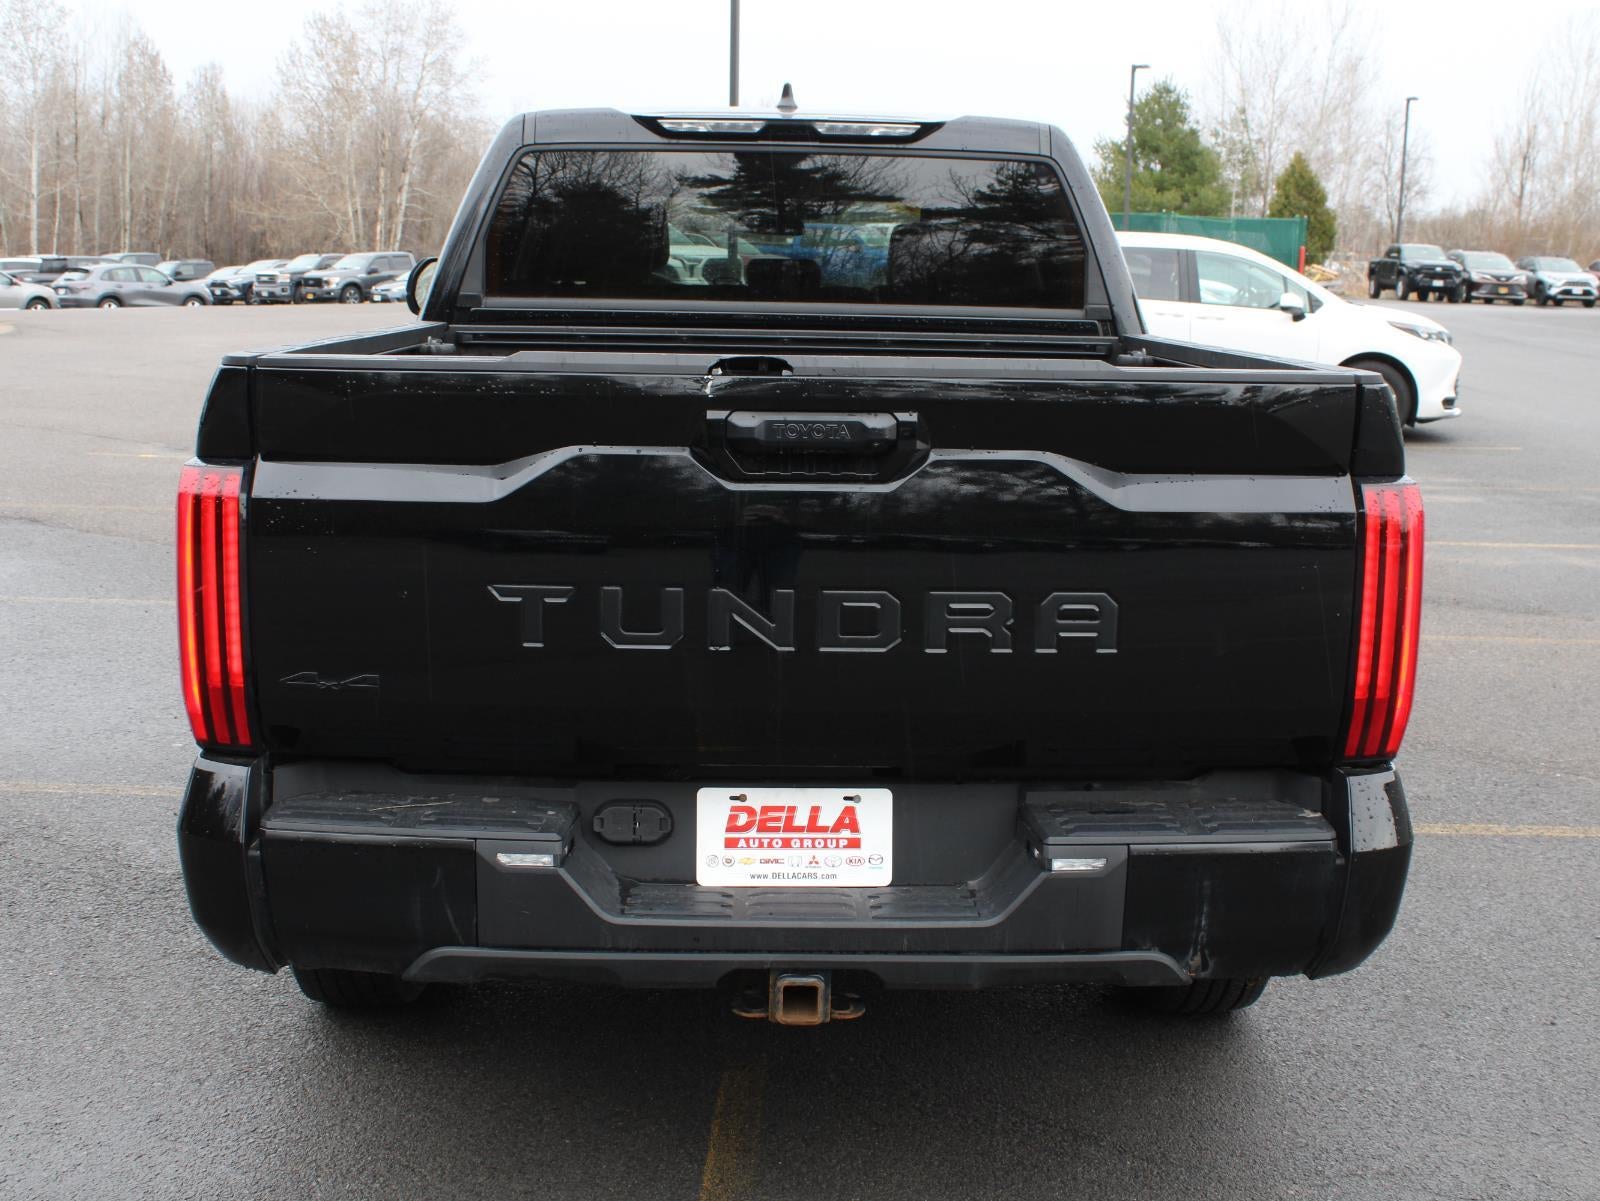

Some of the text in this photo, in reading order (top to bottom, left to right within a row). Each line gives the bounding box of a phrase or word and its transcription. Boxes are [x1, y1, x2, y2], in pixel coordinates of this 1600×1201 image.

[772, 423, 851, 439] TOYOTA
[486, 584, 1120, 655] TUNDRA
[725, 805, 861, 835] DELLA
[737, 838, 849, 848] AUTO GROUP
[749, 872, 837, 880] www.DELLACARS.com
